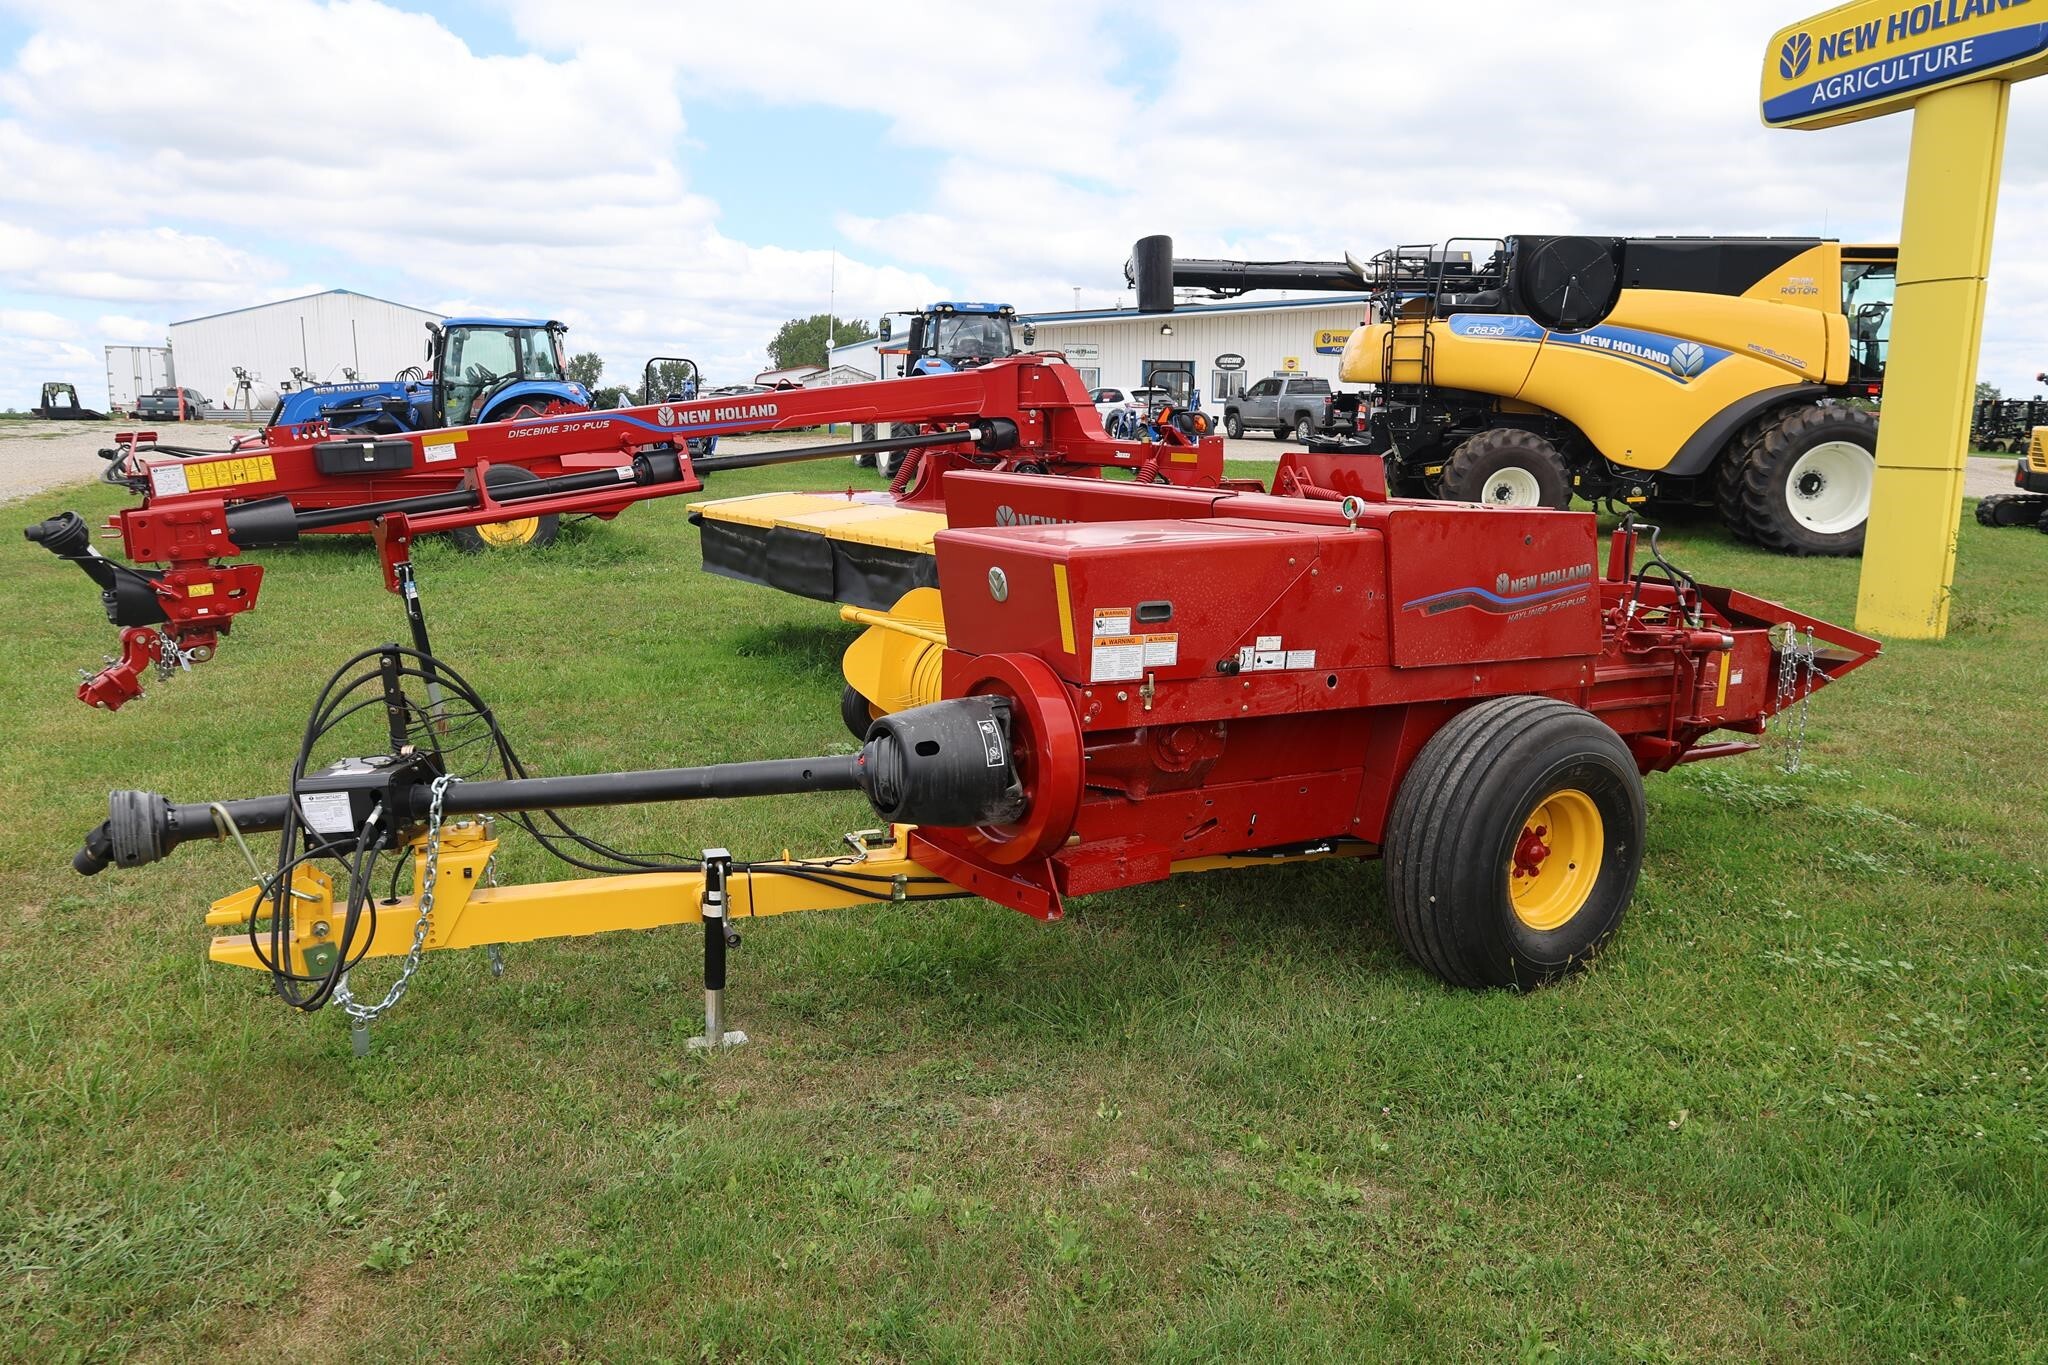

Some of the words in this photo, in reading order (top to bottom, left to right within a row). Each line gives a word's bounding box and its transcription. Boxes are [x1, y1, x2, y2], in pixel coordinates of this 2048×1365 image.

[1817, 19, 1881, 65] NEW
[1886, 0, 2032, 43] HOLLA
[1811, 40, 1974, 104] AGRICULTURE
[1781, 286, 1819, 295] ROTOR
[1466, 326, 1505, 335] CR8.90
[1580, 334, 1611, 348] NEW
[1612, 341, 1670, 365] HOLLAND
[1747, 343, 1807, 368] REVELATION
[313, 386, 335, 395] NEW
[337, 383, 380, 393] HOLLAND
[678, 409, 711, 425] NEW
[714, 403, 778, 421] HOLLAND
[508, 425, 560, 439] DISCBINE
[562, 423, 580, 433] 310
[1511, 575, 1537, 592] NEW
[1541, 564, 1591, 585] HOLLAND
[1507, 605, 1548, 623] HAYLINER
